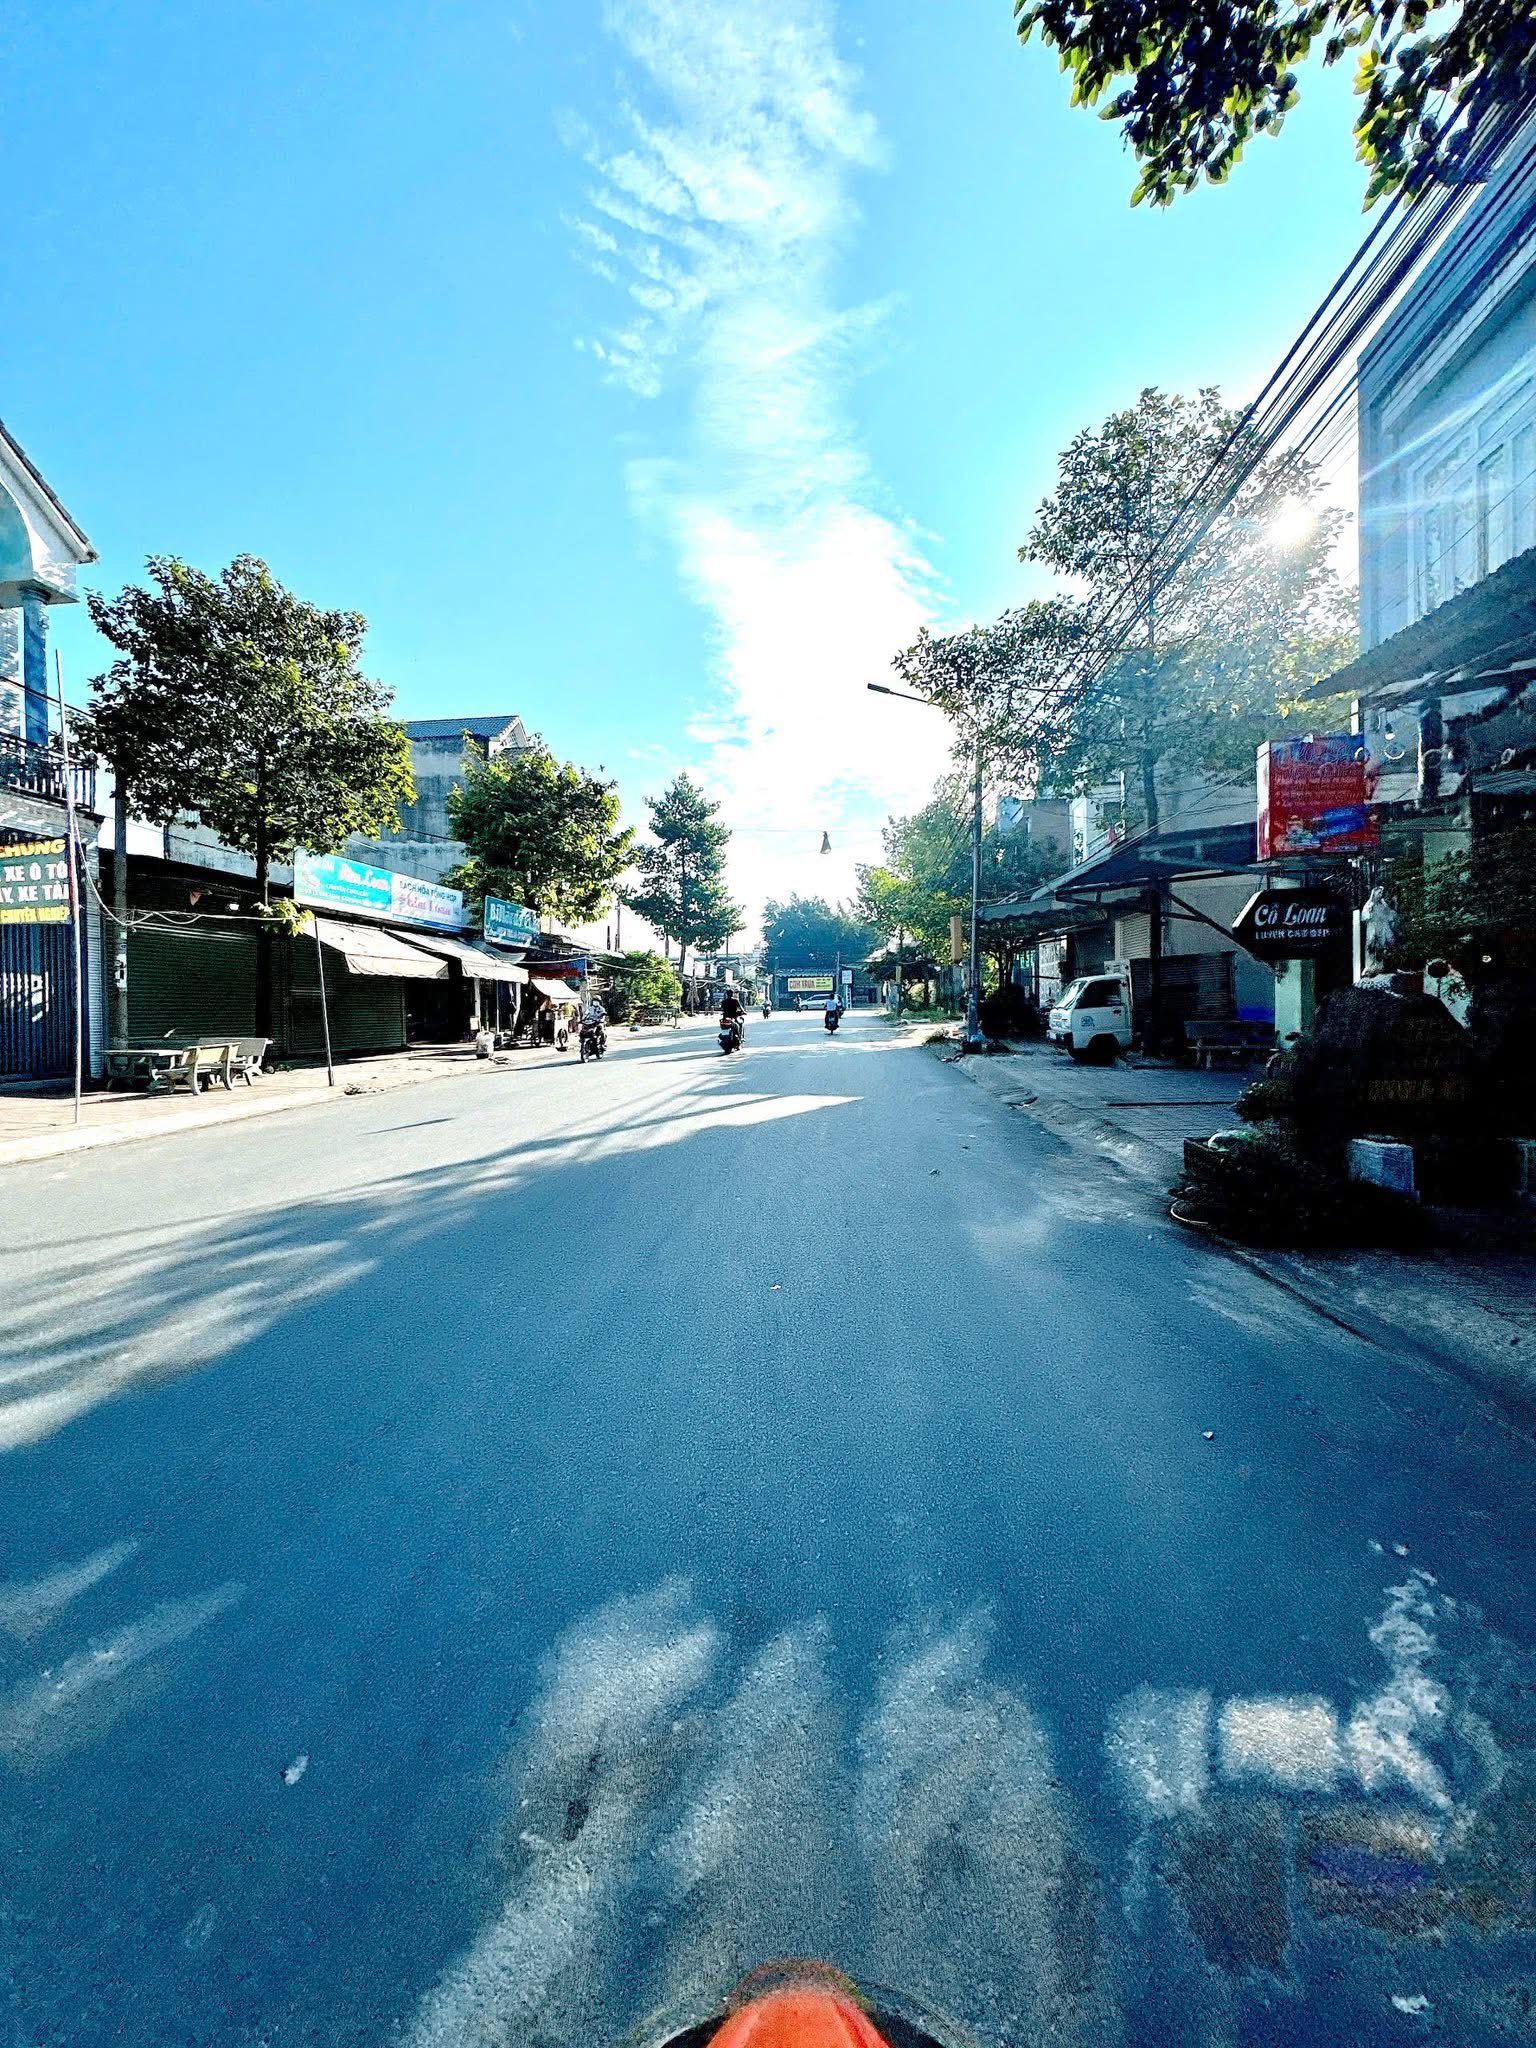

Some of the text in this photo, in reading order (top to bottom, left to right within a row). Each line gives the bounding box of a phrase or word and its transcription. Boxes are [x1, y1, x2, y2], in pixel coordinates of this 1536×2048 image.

[4, 860, 68, 882] XE Ô TÔ
[18, 886, 38, 902] XE
[1254, 903, 1328, 927] Cô Loan
